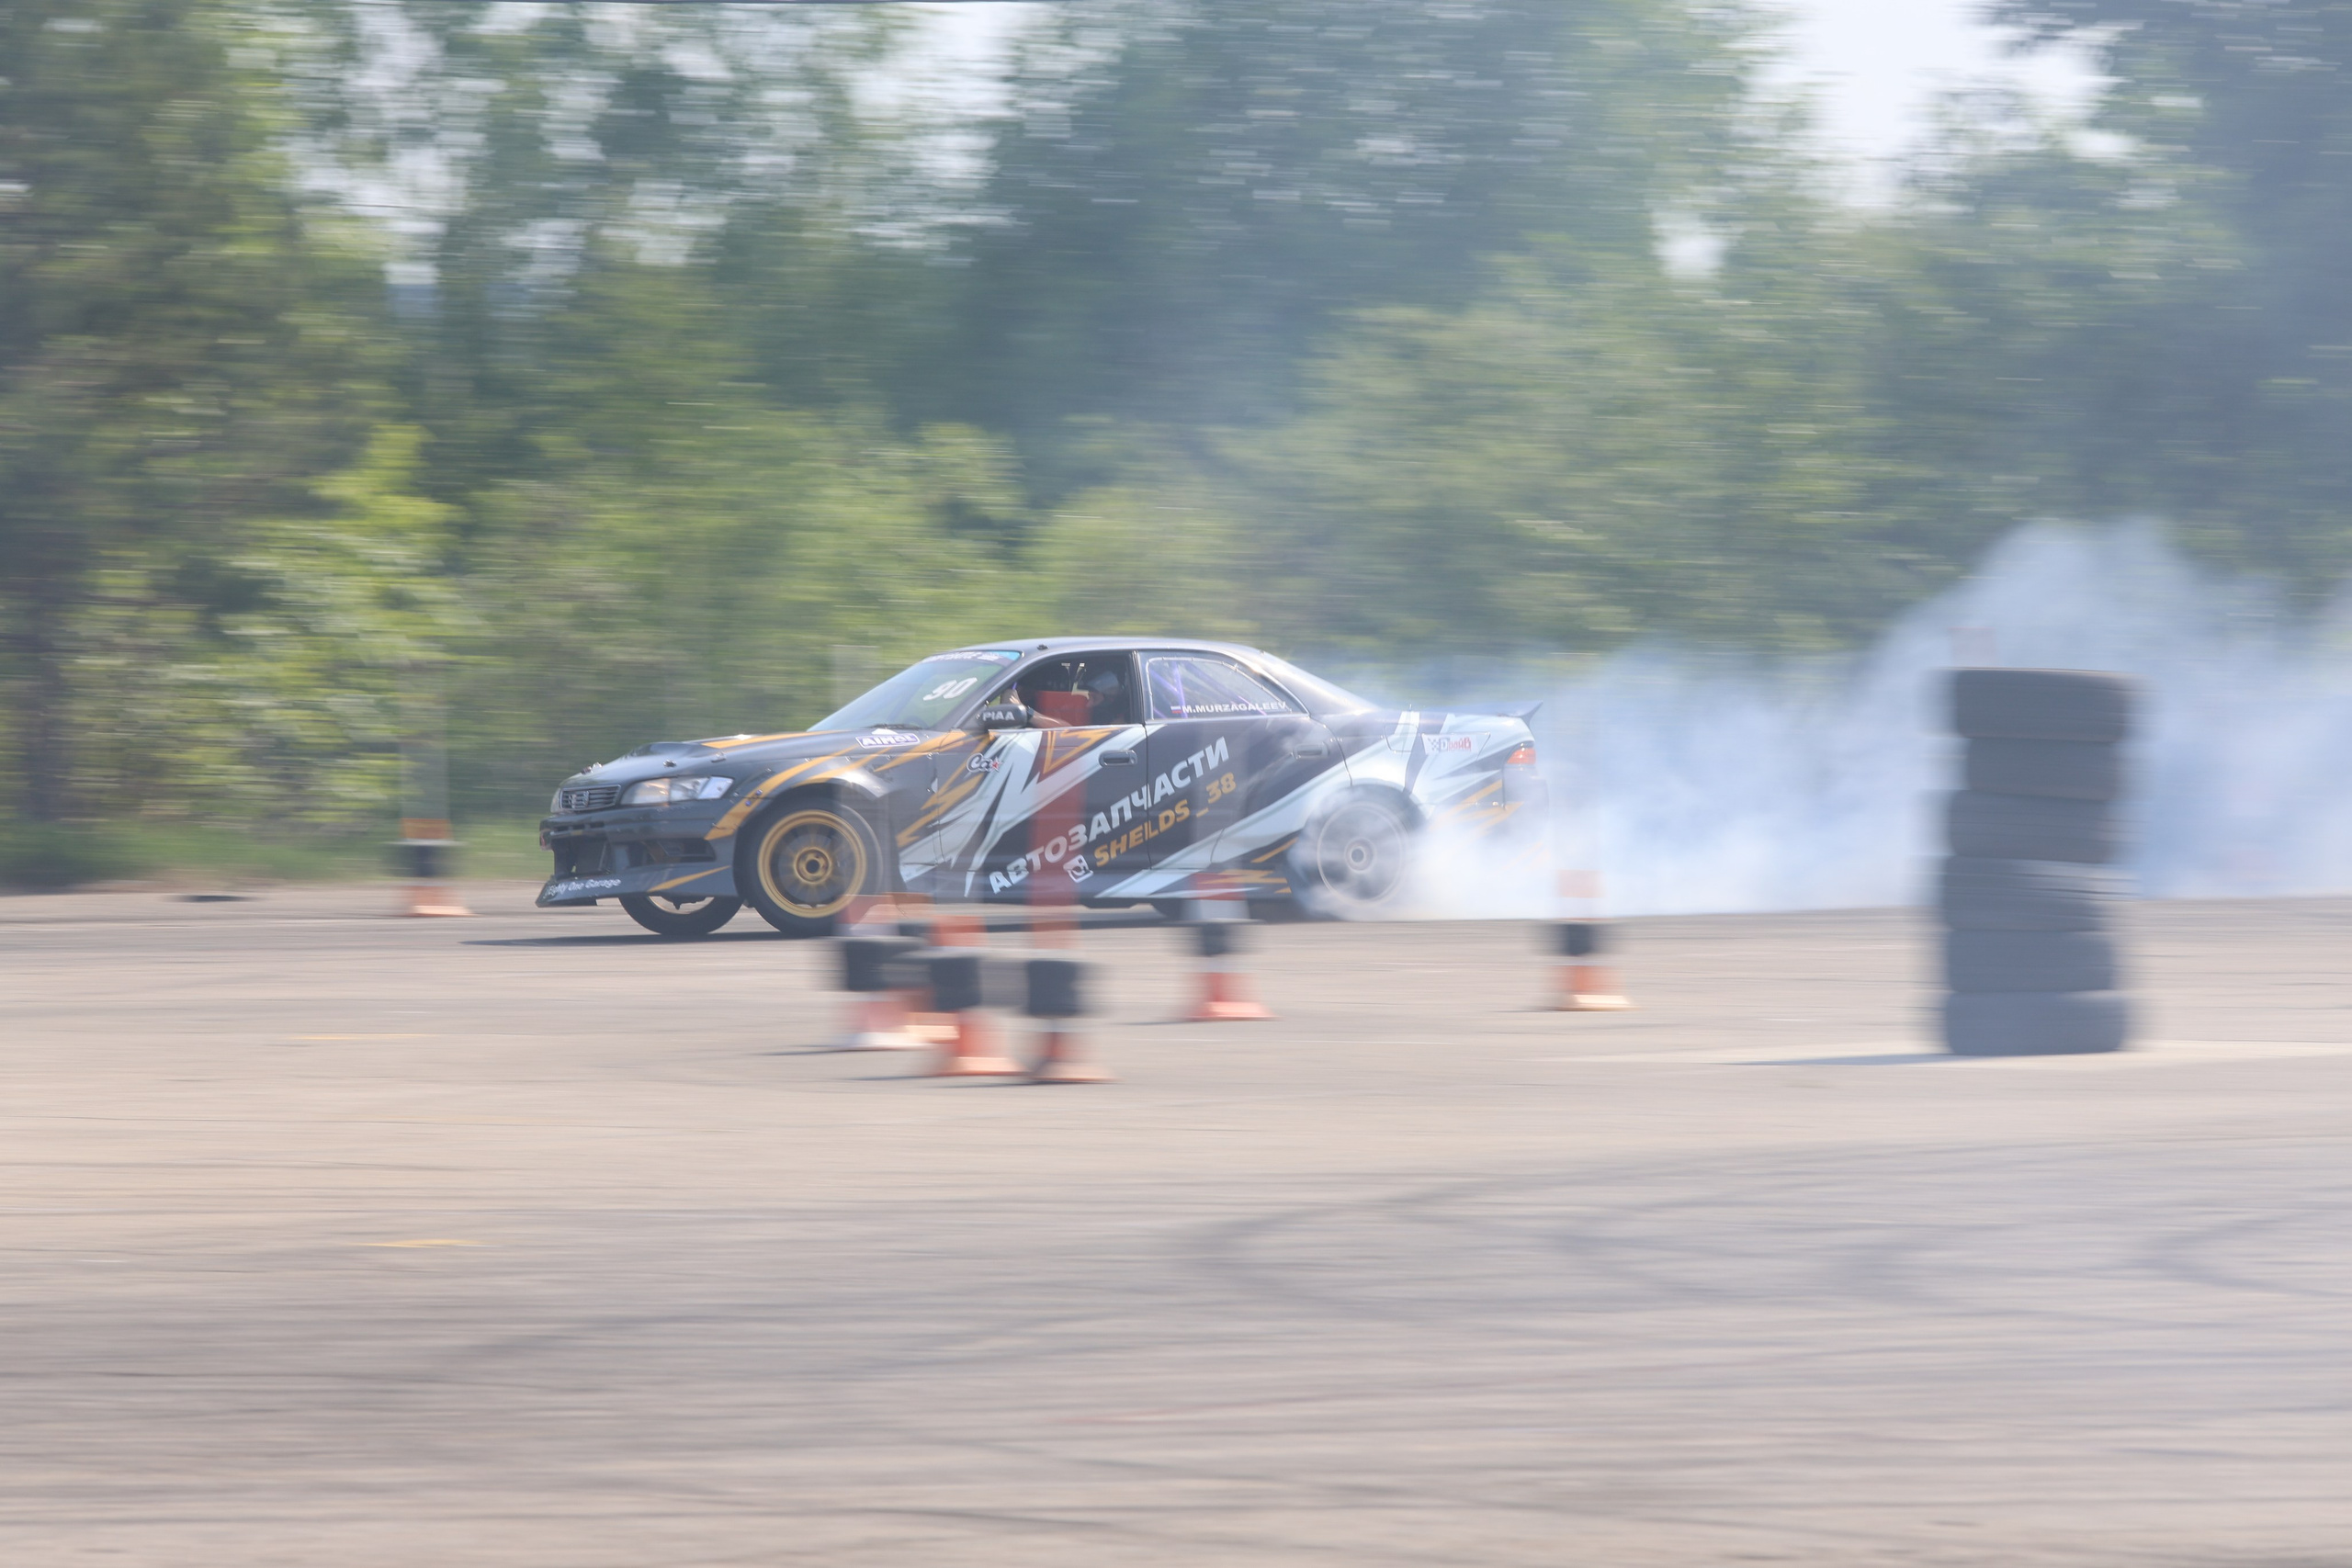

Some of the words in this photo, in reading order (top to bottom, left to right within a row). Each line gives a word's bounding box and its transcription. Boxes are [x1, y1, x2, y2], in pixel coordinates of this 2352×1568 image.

[923, 677, 978, 701] 90
[982, 710, 1015, 722] PIAA
[989, 736, 1229, 894] АВТОЗАПЧАСТИ
[585, 879, 622, 889] Garage
